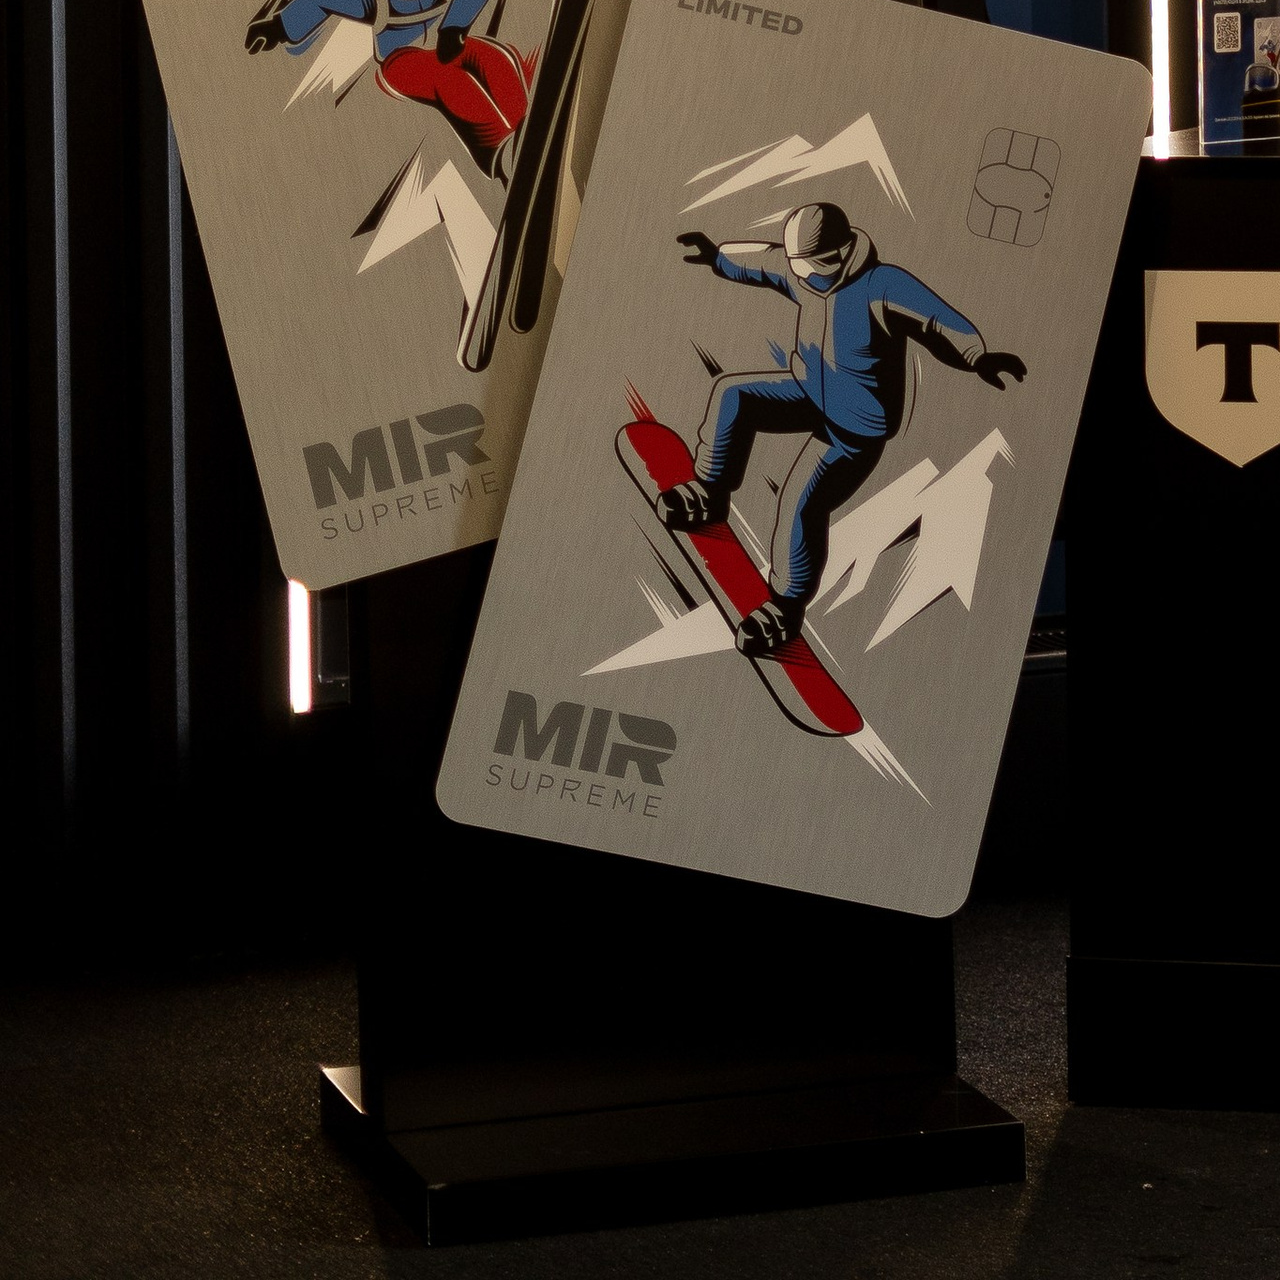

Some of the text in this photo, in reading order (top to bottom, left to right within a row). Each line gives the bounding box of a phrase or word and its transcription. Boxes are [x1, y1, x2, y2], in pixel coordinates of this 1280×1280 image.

[1196, 321, 1280, 403] T
[302, 403, 491, 510] MIR
[321, 471, 499, 540] SUPREME
[493, 690, 677, 786] MIR
[485, 764, 663, 818] SUPREME
